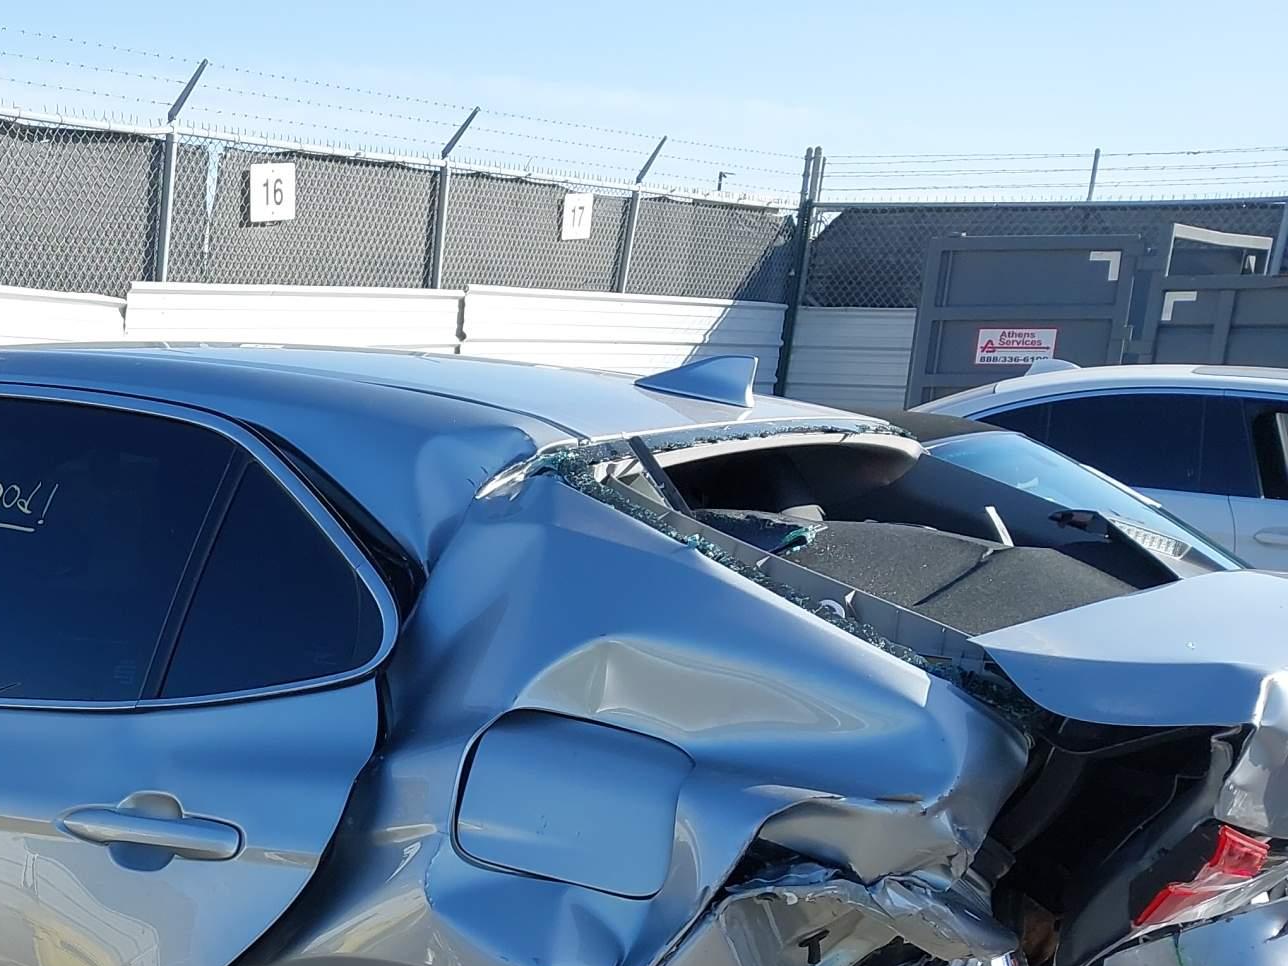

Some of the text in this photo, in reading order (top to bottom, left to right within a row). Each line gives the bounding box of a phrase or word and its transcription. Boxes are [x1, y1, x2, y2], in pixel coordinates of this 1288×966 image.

[263, 178, 283, 205] 16
[572, 206, 584, 227] 17
[998, 338, 1042, 346] Services
